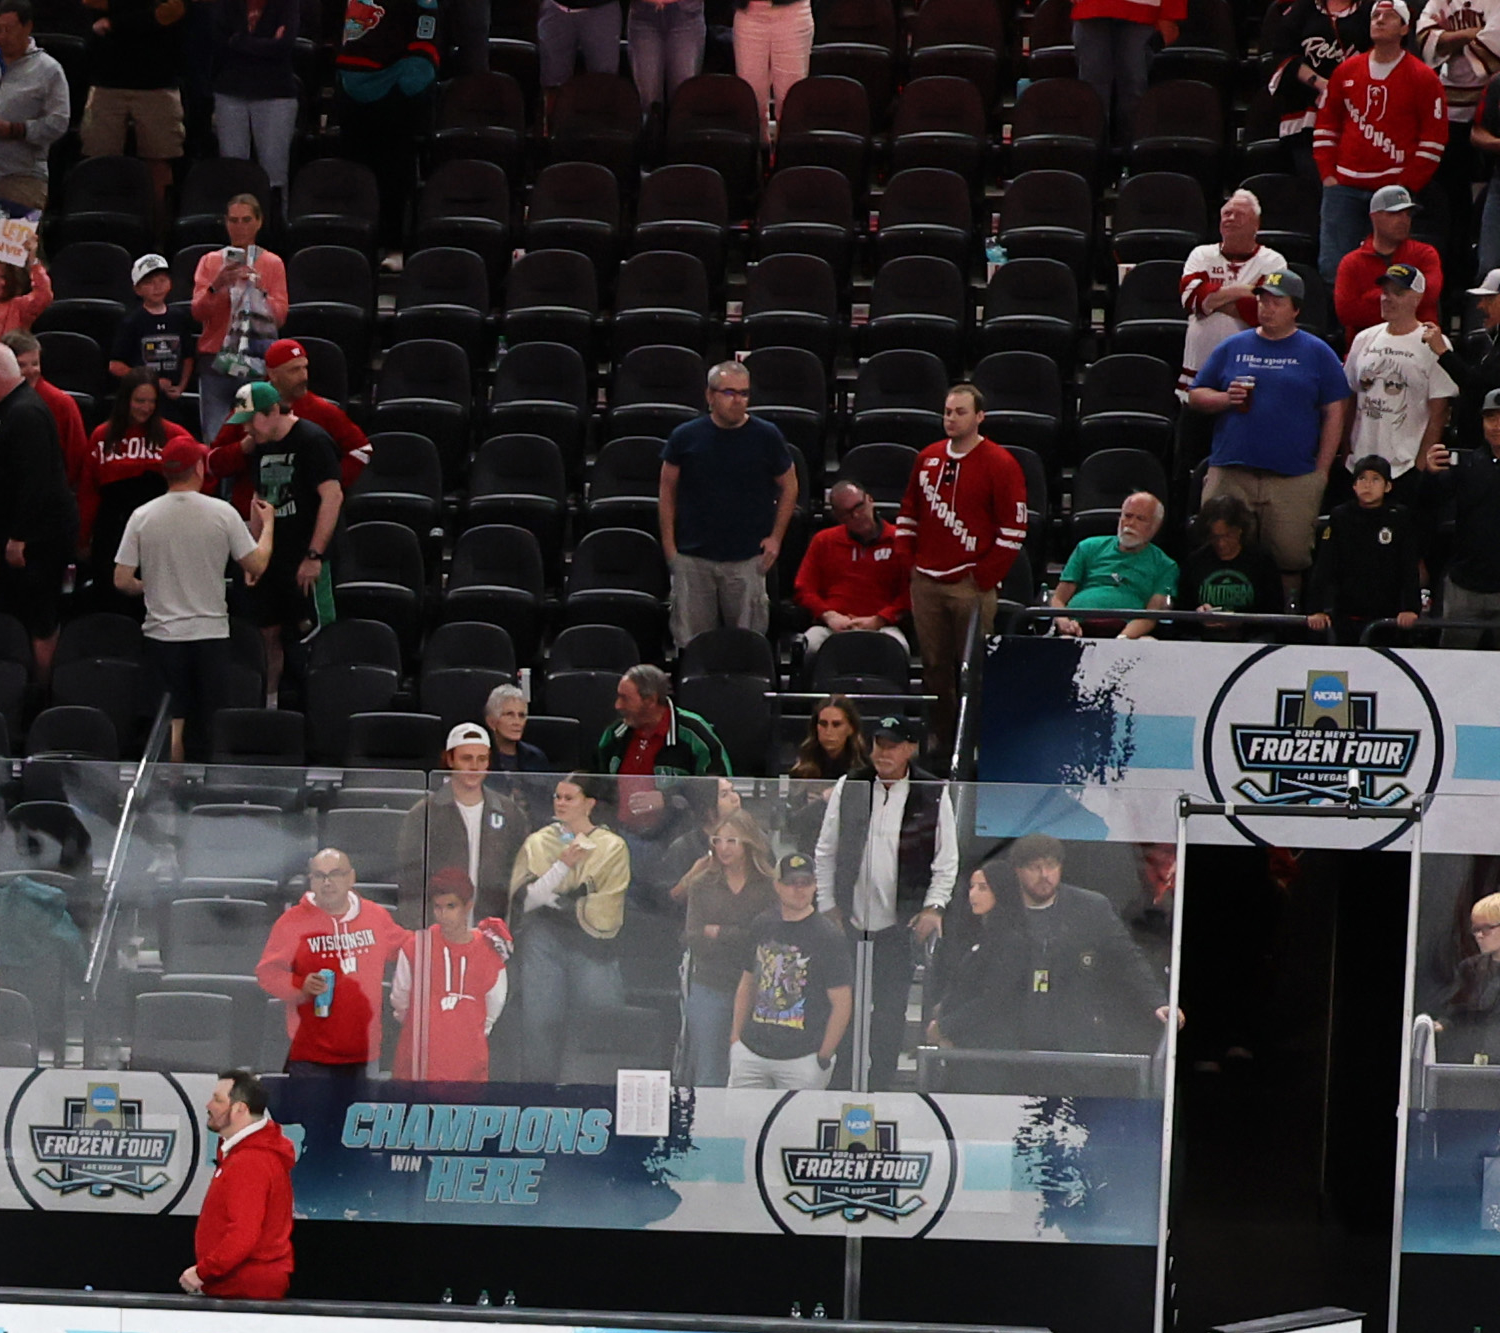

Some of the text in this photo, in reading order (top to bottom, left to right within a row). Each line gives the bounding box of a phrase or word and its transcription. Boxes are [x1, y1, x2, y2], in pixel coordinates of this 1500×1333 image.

[1267, 274, 1283, 285] M
[918, 469, 976, 552] WISCONSIN
[1312, 690, 1343, 702] NCAA
[1294, 730, 1356, 739] 2026 MEN'S
[1248, 740, 1404, 766] FROZEN FOUR
[1296, 772, 1347, 782] LAS VEGAS
[306, 930, 376, 954] WISCONSIN
[342, 1103, 612, 1155] CHAMPIONS
[42, 1136, 165, 1161] FROZEN FOUR
[390, 1155, 546, 1205] WIN HERE
[794, 1156, 921, 1183] FROZEN FOUR
